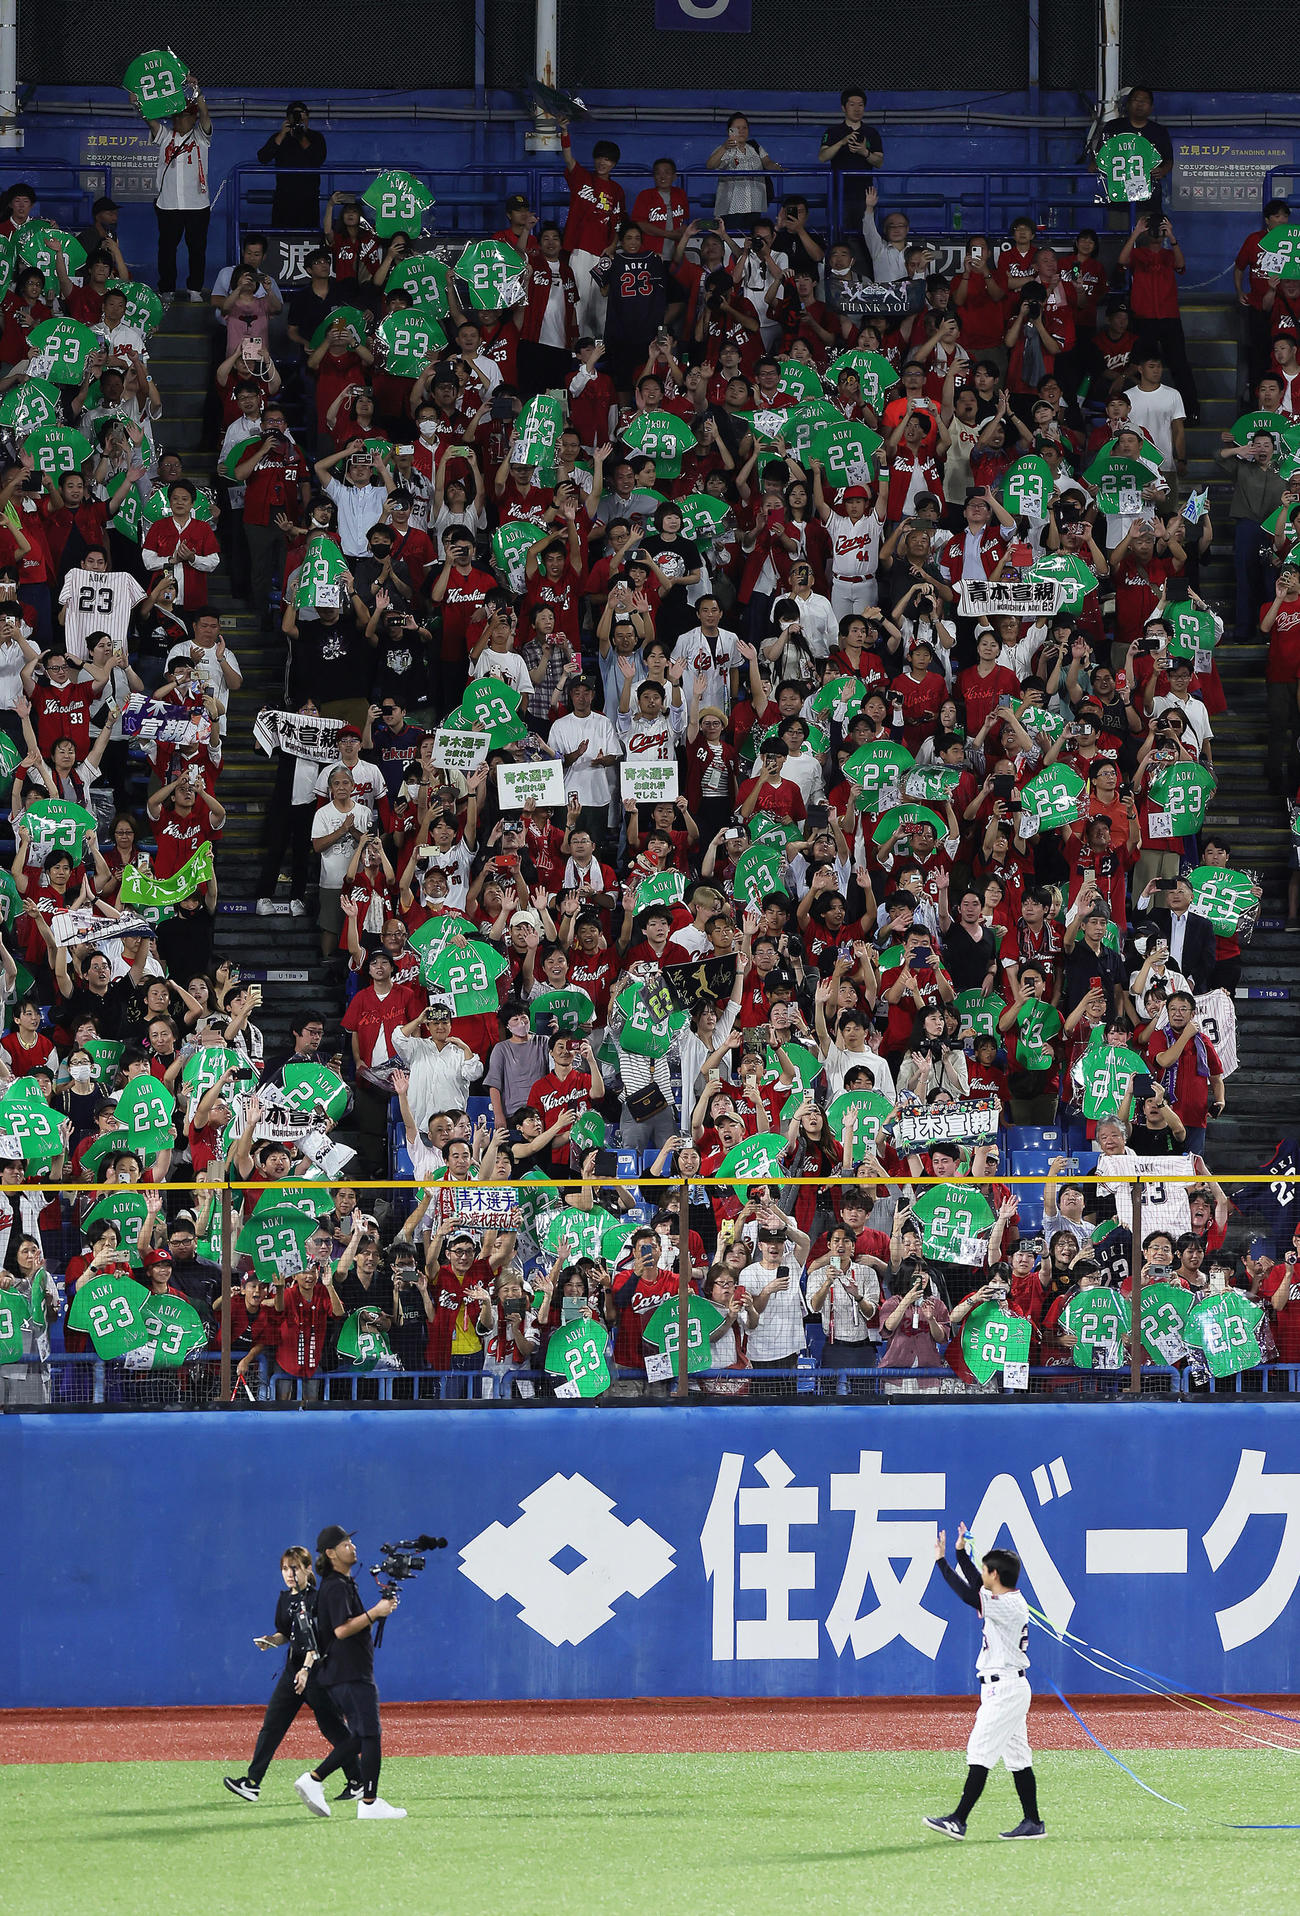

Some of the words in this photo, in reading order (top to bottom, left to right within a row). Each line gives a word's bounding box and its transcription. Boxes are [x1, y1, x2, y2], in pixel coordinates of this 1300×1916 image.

[144, 59, 163, 71] AOKI
[140, 70, 177, 100] 23
[88, 136, 138, 147] 立見エリア
[1118, 142, 1137, 151] AOKI
[1179, 145, 1230, 156] 立見エリア
[1112, 156, 1144, 181] 23
[382, 193, 415, 218] 23
[407, 264, 425, 275] AOKI
[624, 262, 648, 271] AOKI
[473, 262, 508, 290] 23
[620, 271, 653, 297] 23
[403, 275, 440, 305] 23
[840, 302, 881, 312] THANK
[886, 302, 910, 312] YOU
[124, 301, 151, 332] 23
[404, 318, 424, 327] AOKI
[56, 323, 76, 334] AOKI
[394, 330, 429, 357] 23
[735, 332, 750, 345] 51
[44, 336, 81, 364] 23
[494, 350, 507, 361] 33
[784, 367, 802, 377] AOKI
[16, 385, 34, 400] AOKI
[14, 396, 50, 426] 23
[649, 420, 670, 430] AOKI
[1253, 420, 1272, 428] AOKI
[45, 433, 64, 442] AOKI
[833, 430, 852, 440] AOKI
[642, 433, 676, 459] 23
[39, 446, 75, 472] 23
[828, 442, 863, 470] 23
[285, 469, 297, 480] 20
[1109, 464, 1128, 472] AOKI
[1009, 475, 1043, 495] 23
[1101, 475, 1136, 493] 23
[413, 504, 425, 516] 23
[681, 510, 713, 540] 23
[836, 533, 872, 555] Carp
[992, 550, 999, 561] 6
[88, 574, 107, 583] AOKI
[300, 559, 329, 587] 23
[968, 582, 1054, 602] 青木宣親
[79, 587, 113, 614] 23
[1042, 602, 1054, 611] 23
[1179, 614, 1200, 650] 23
[475, 686, 492, 698] AOKI
[44, 699, 84, 715] Hiroshima
[126, 693, 172, 716] 青木
[70, 712, 83, 724] 33
[474, 698, 511, 728] 23
[138, 718, 188, 741] 宣親
[439, 735, 486, 749] 青木選手
[629, 730, 669, 753] Carp
[328, 749, 340, 759] 23
[383, 747, 418, 761] akult
[445, 749, 475, 758] お疲れ様
[658, 748, 669, 760] 12
[873, 752, 893, 761] AOKI
[504, 768, 554, 784] 青木選手
[624, 767, 674, 781] 青木選手
[864, 764, 900, 792] 23
[1038, 772, 1057, 785] AOKI
[1177, 773, 1194, 781] AOKI
[515, 783, 546, 793] お疲れ様
[634, 782, 666, 792] お疲れ様
[1035, 787, 1070, 817] 23
[1170, 786, 1202, 814] 23
[48, 806, 66, 814] AOKI
[899, 814, 919, 823] AOKI
[40, 820, 76, 845] 23
[163, 821, 200, 839] Hiroshima
[191, 838, 198, 849] 2
[744, 858, 758, 873] AOKI
[745, 862, 774, 897] 23
[1213, 873, 1233, 883] AOKI
[653, 885, 672, 896] AOKI
[1201, 885, 1236, 915] 23
[455, 952, 476, 962] AOKI
[449, 963, 488, 995] 23
[571, 963, 609, 982] Hiroshima
[783, 972, 790, 981] H
[549, 1000, 569, 1010] AOKI
[649, 988, 674, 1020] 23
[966, 999, 984, 1008] AOKI
[1020, 1018, 1044, 1048] 23
[95, 1050, 116, 1058] AOKI
[137, 1084, 152, 1096] AOKI
[1092, 1070, 1128, 1098] 23
[540, 1088, 588, 1112] Hiroshima
[850, 1101, 871, 1110] AOKI
[133, 1099, 169, 1132] 23
[9, 1113, 51, 1136] 23
[900, 1111, 991, 1141] 青木宣親
[272, 1129, 304, 1137] NORICHIKA
[741, 1142, 760, 1157] AOKI
[735, 1149, 770, 1174] 23
[1135, 1163, 1154, 1173] AOKI
[458, 1190, 516, 1213] 青木選手
[945, 1192, 968, 1205] AOKI
[113, 1202, 135, 1213] AOKI
[262, 1218, 284, 1229] AOKI
[931, 1208, 973, 1237] 23
[256, 1228, 298, 1262] 23
[568, 1226, 599, 1266] 23
[91, 1285, 113, 1299] AOKI
[1092, 1299, 1111, 1308] AOKI
[1140, 1294, 1158, 1311] AOKI
[89, 1297, 134, 1337] 23
[158, 1304, 181, 1318] AOKI
[1081, 1314, 1118, 1344] 23
[1140, 1302, 1184, 1346] 23
[145, 1318, 183, 1355] 23
[566, 1328, 586, 1344] AOKI
[664, 1318, 703, 1353] 23
[970, 1328, 979, 1350] AOKI
[982, 1321, 1010, 1364] 23
[1203, 1316, 1248, 1355] 23
[565, 1339, 600, 1379] 23
[700, 1449, 1300, 1660] 住友ベーク
